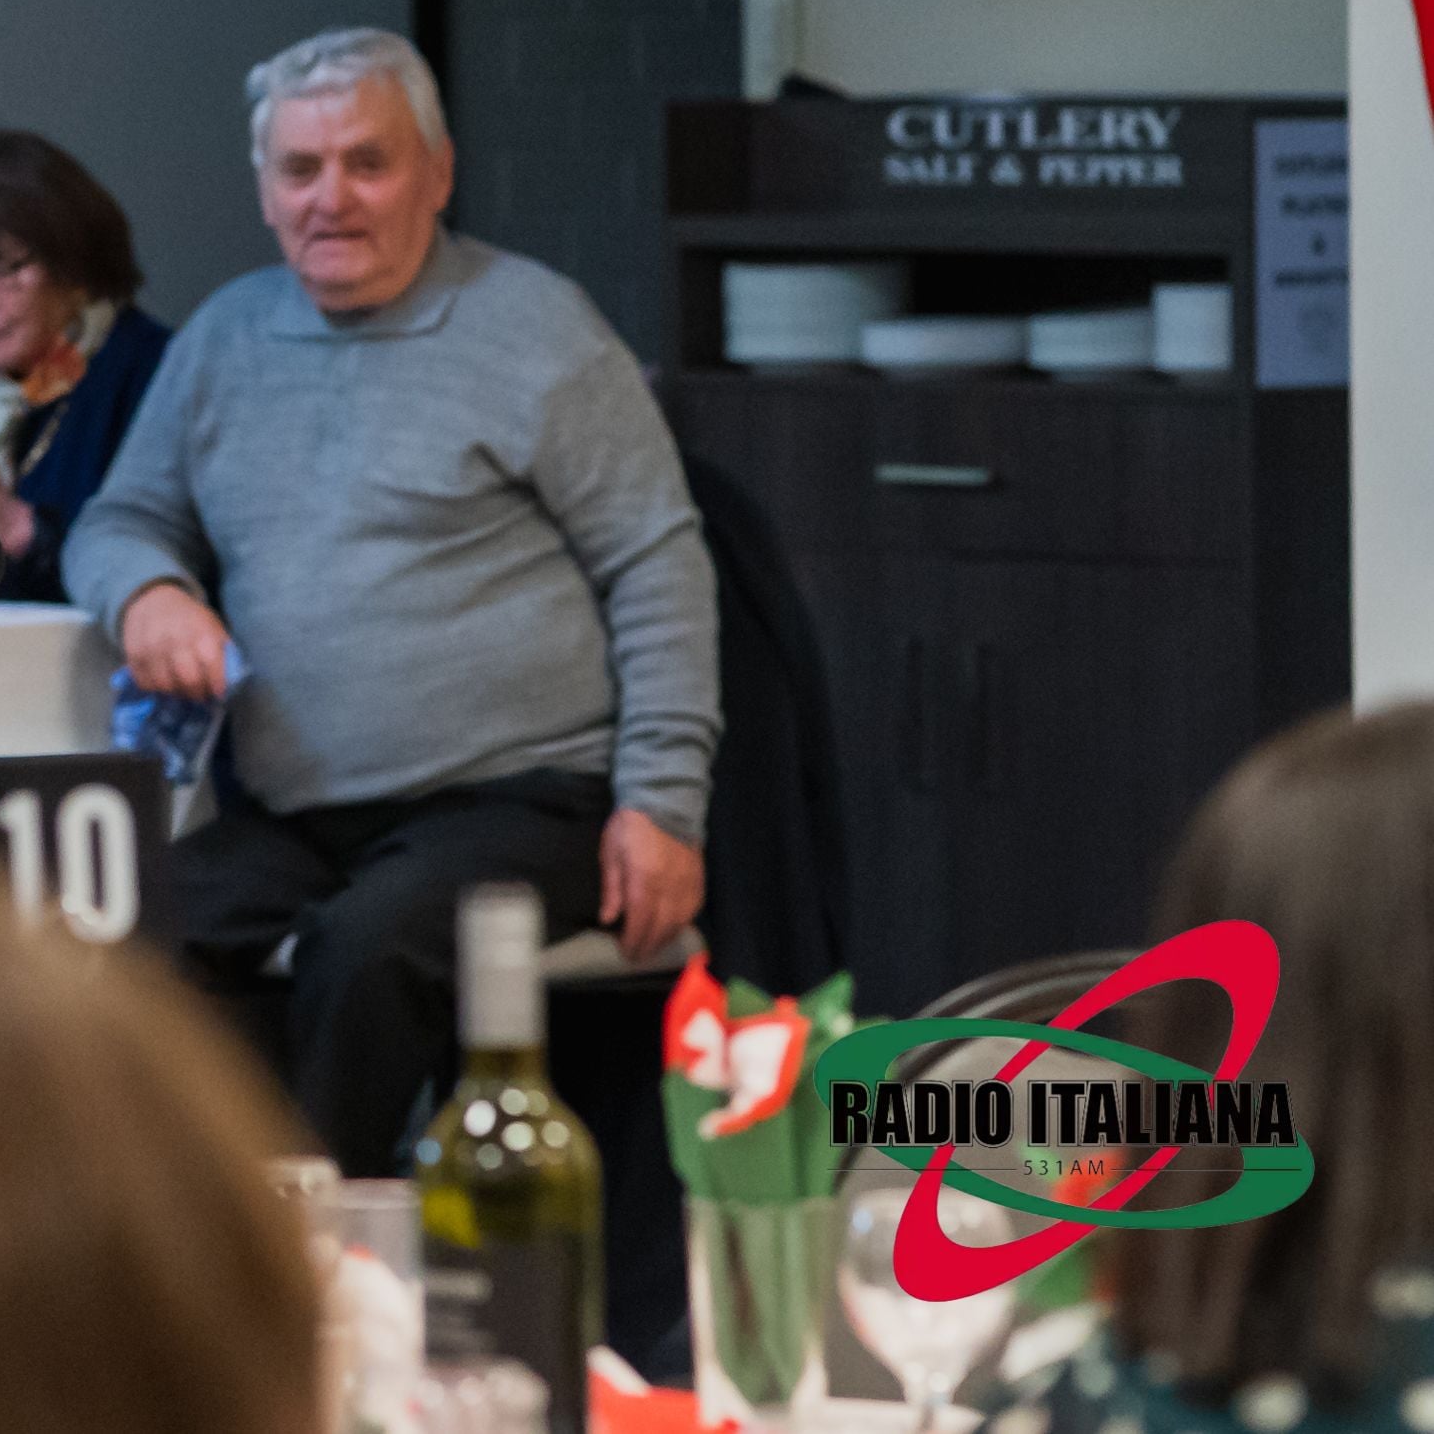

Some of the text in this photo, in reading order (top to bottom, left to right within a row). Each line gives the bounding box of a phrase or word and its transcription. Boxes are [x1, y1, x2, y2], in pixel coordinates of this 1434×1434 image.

[885, 107, 1181, 149] CUTLERY
[884, 152, 1182, 187] SALT & PEPPER
